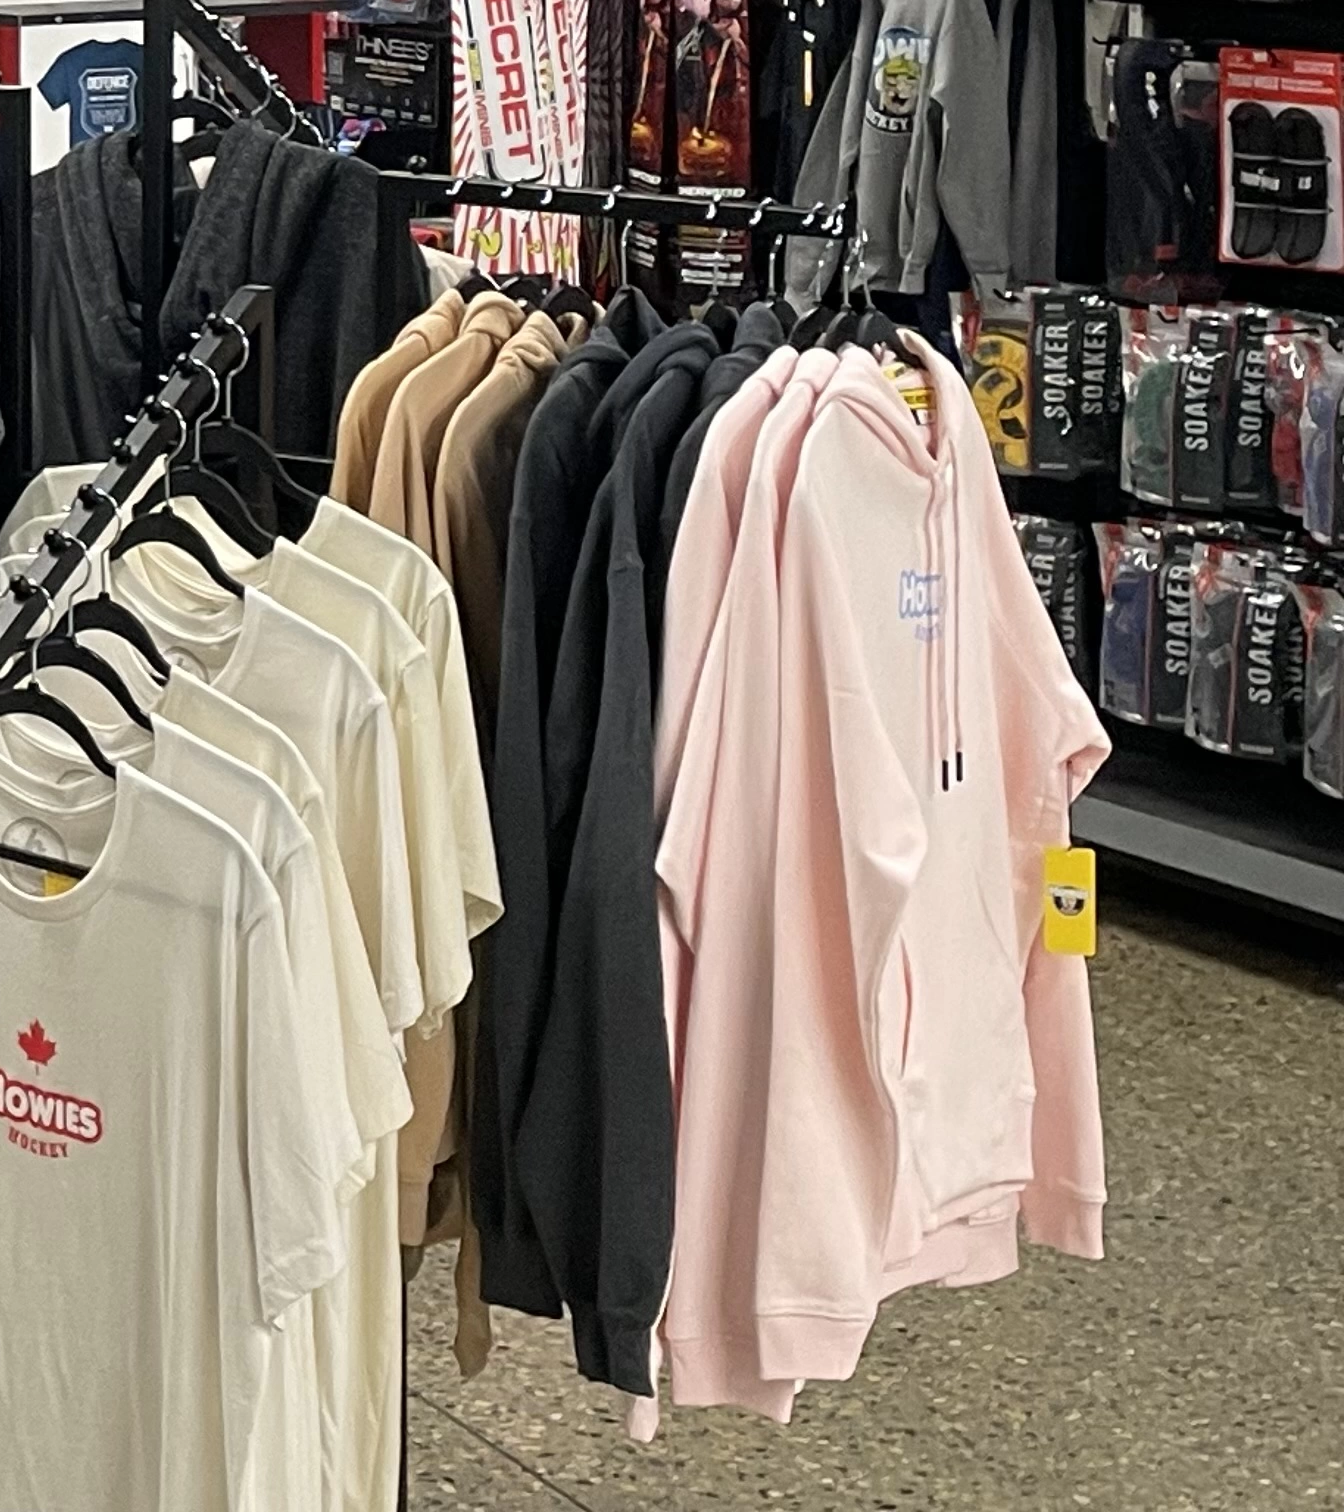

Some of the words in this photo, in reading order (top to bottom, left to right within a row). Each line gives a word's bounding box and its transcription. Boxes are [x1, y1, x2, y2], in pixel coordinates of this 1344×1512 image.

[475, 92, 493, 147] MINIS
[1043, 323, 1071, 420] SOAKER
[1080, 319, 1109, 416] SOAKER
[1237, 348, 1267, 449] SOAKER
[1165, 563, 1191, 676] SOAKER
[7, 1125, 69, 1159] HOCKEY
